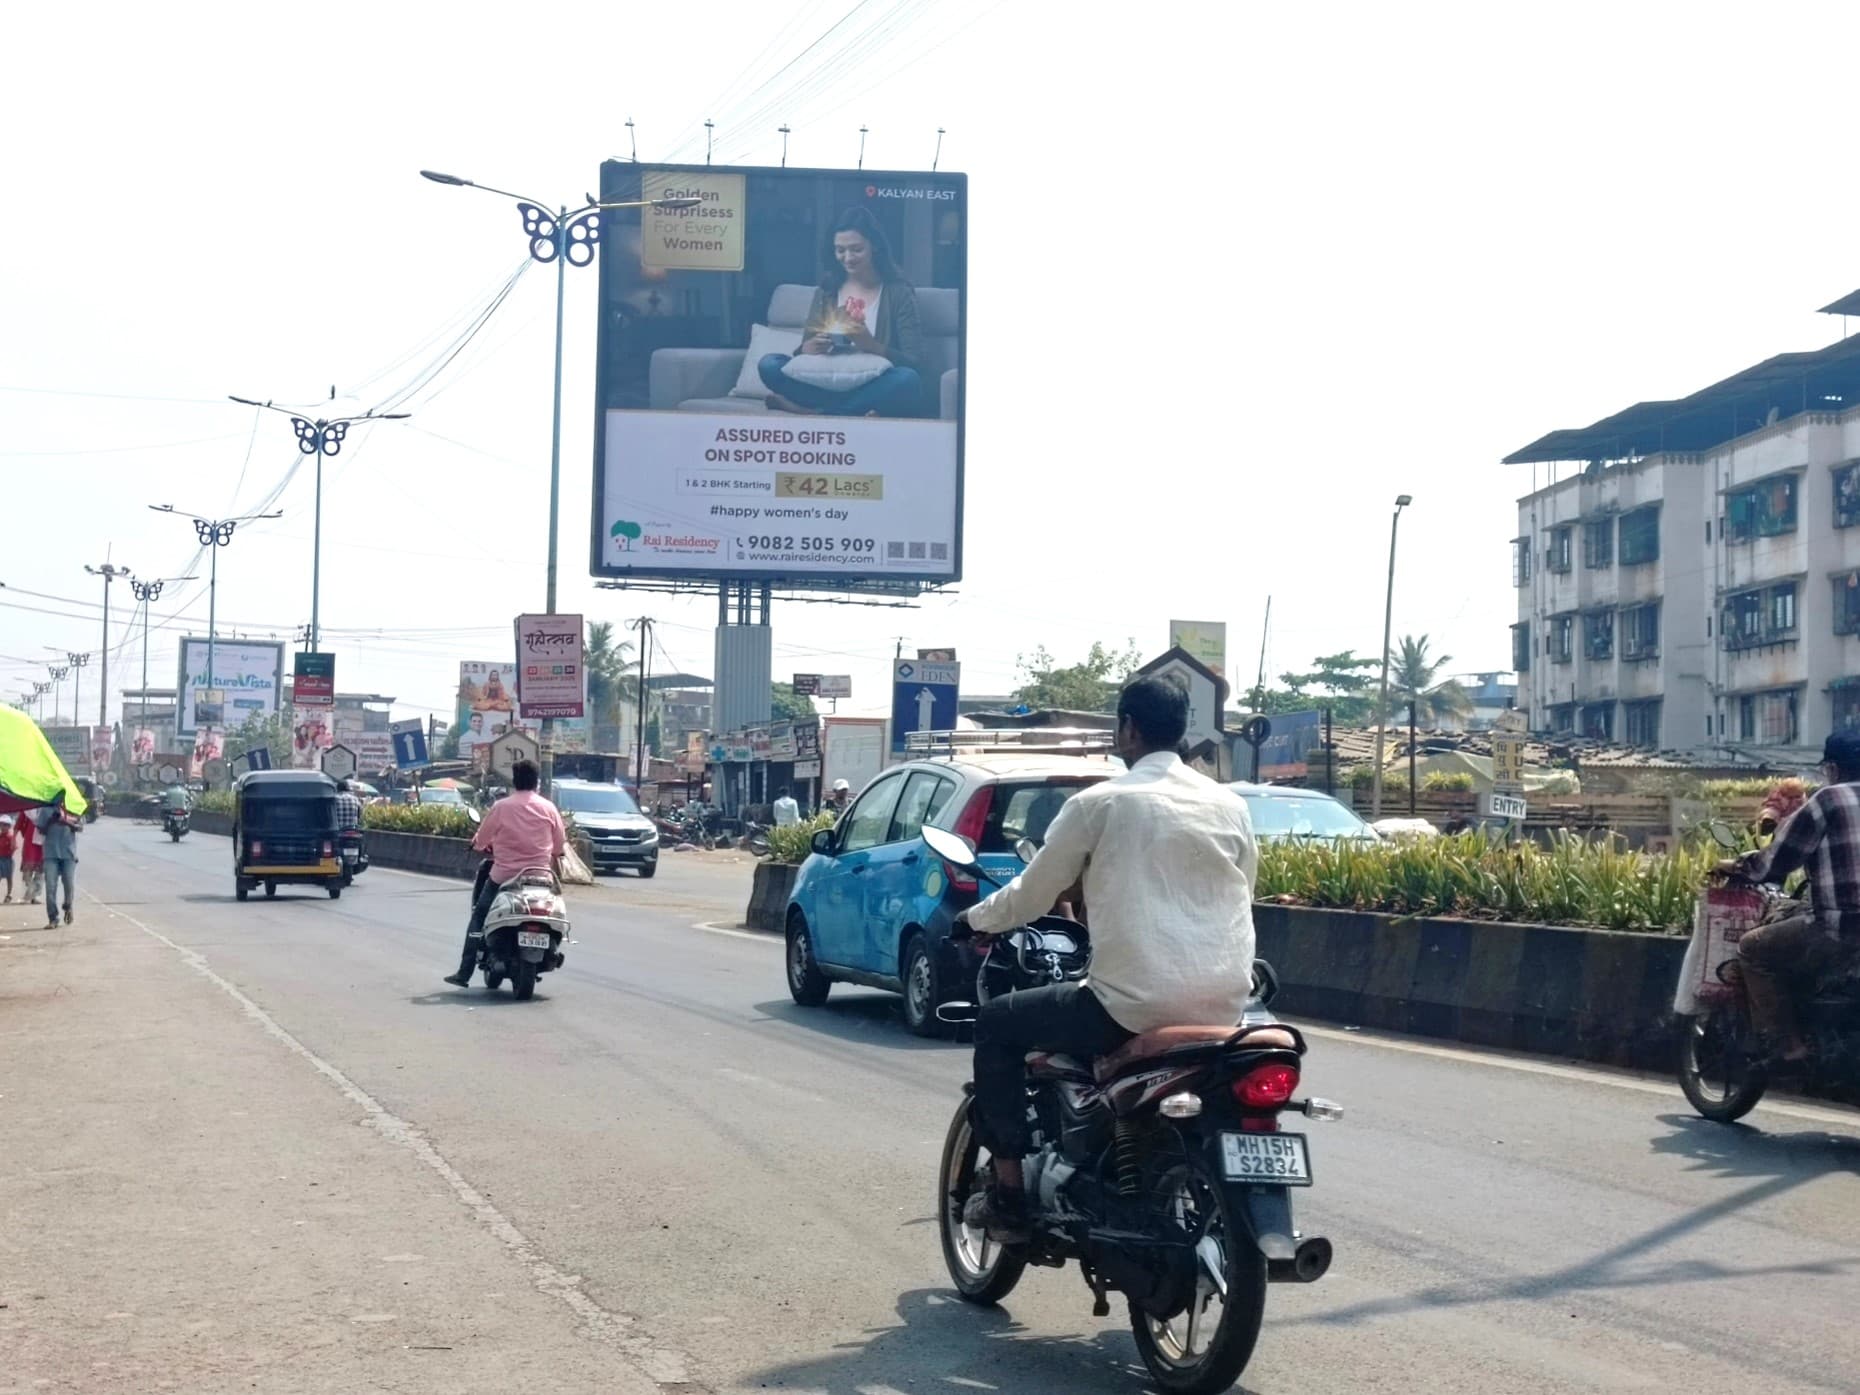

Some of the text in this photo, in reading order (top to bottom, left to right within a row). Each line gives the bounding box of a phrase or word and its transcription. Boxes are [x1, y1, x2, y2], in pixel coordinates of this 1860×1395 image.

[663, 188, 720, 201] Golden
[878, 188, 956, 200] KALYAN EAST
[653, 205, 734, 219] Surprisess
[654, 220, 728, 237] For Every
[663, 237, 723, 250] Women
[715, 428, 846, 445] ASSURED GIFTS
[704, 449, 856, 466] ON SPOT BOOKING
[685, 479, 771, 491] 1 & 2 BHK Starting
[710, 505, 849, 521] #happy women's day
[664, 535, 720, 549] Residency
[748, 536, 875, 551] 9082 505 909
[748, 551, 875, 564] www.rairesidency.com
[1493, 797, 1525, 816] ENTRY
[1236, 1136, 1295, 1156] MH15H
[1240, 1155, 1299, 1175] S2834
